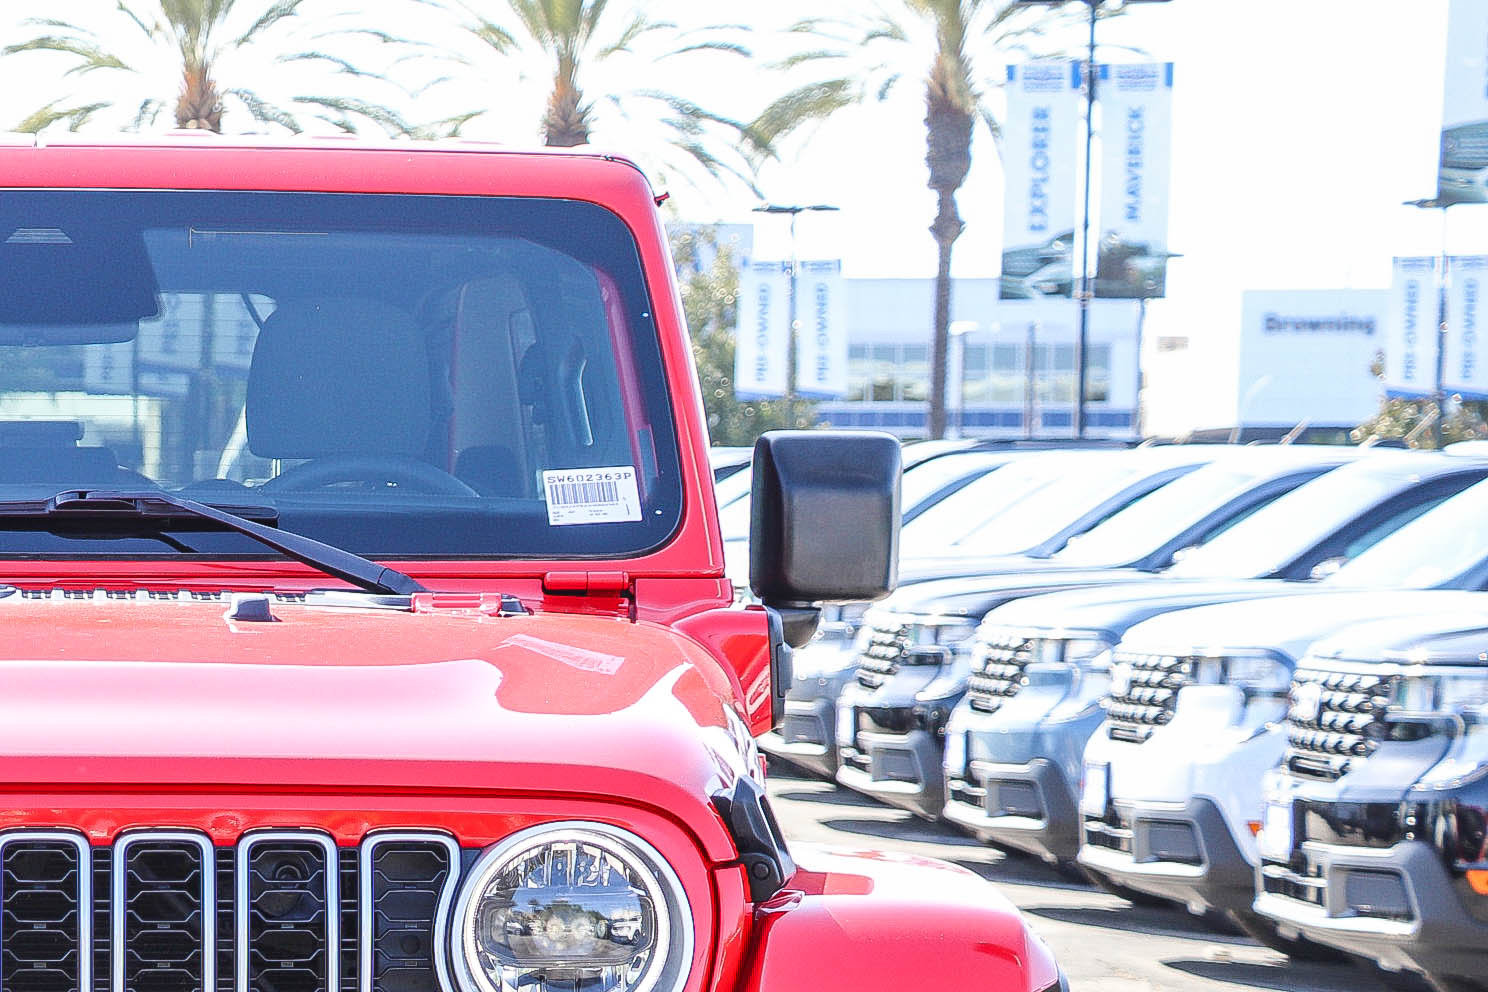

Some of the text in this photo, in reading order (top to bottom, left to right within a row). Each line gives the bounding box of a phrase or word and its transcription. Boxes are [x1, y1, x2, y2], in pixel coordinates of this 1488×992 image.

[1029, 105, 1050, 232] EXPLORER
[1125, 105, 1145, 220] MAVERICK
[547, 472, 632, 484] SW602363P
